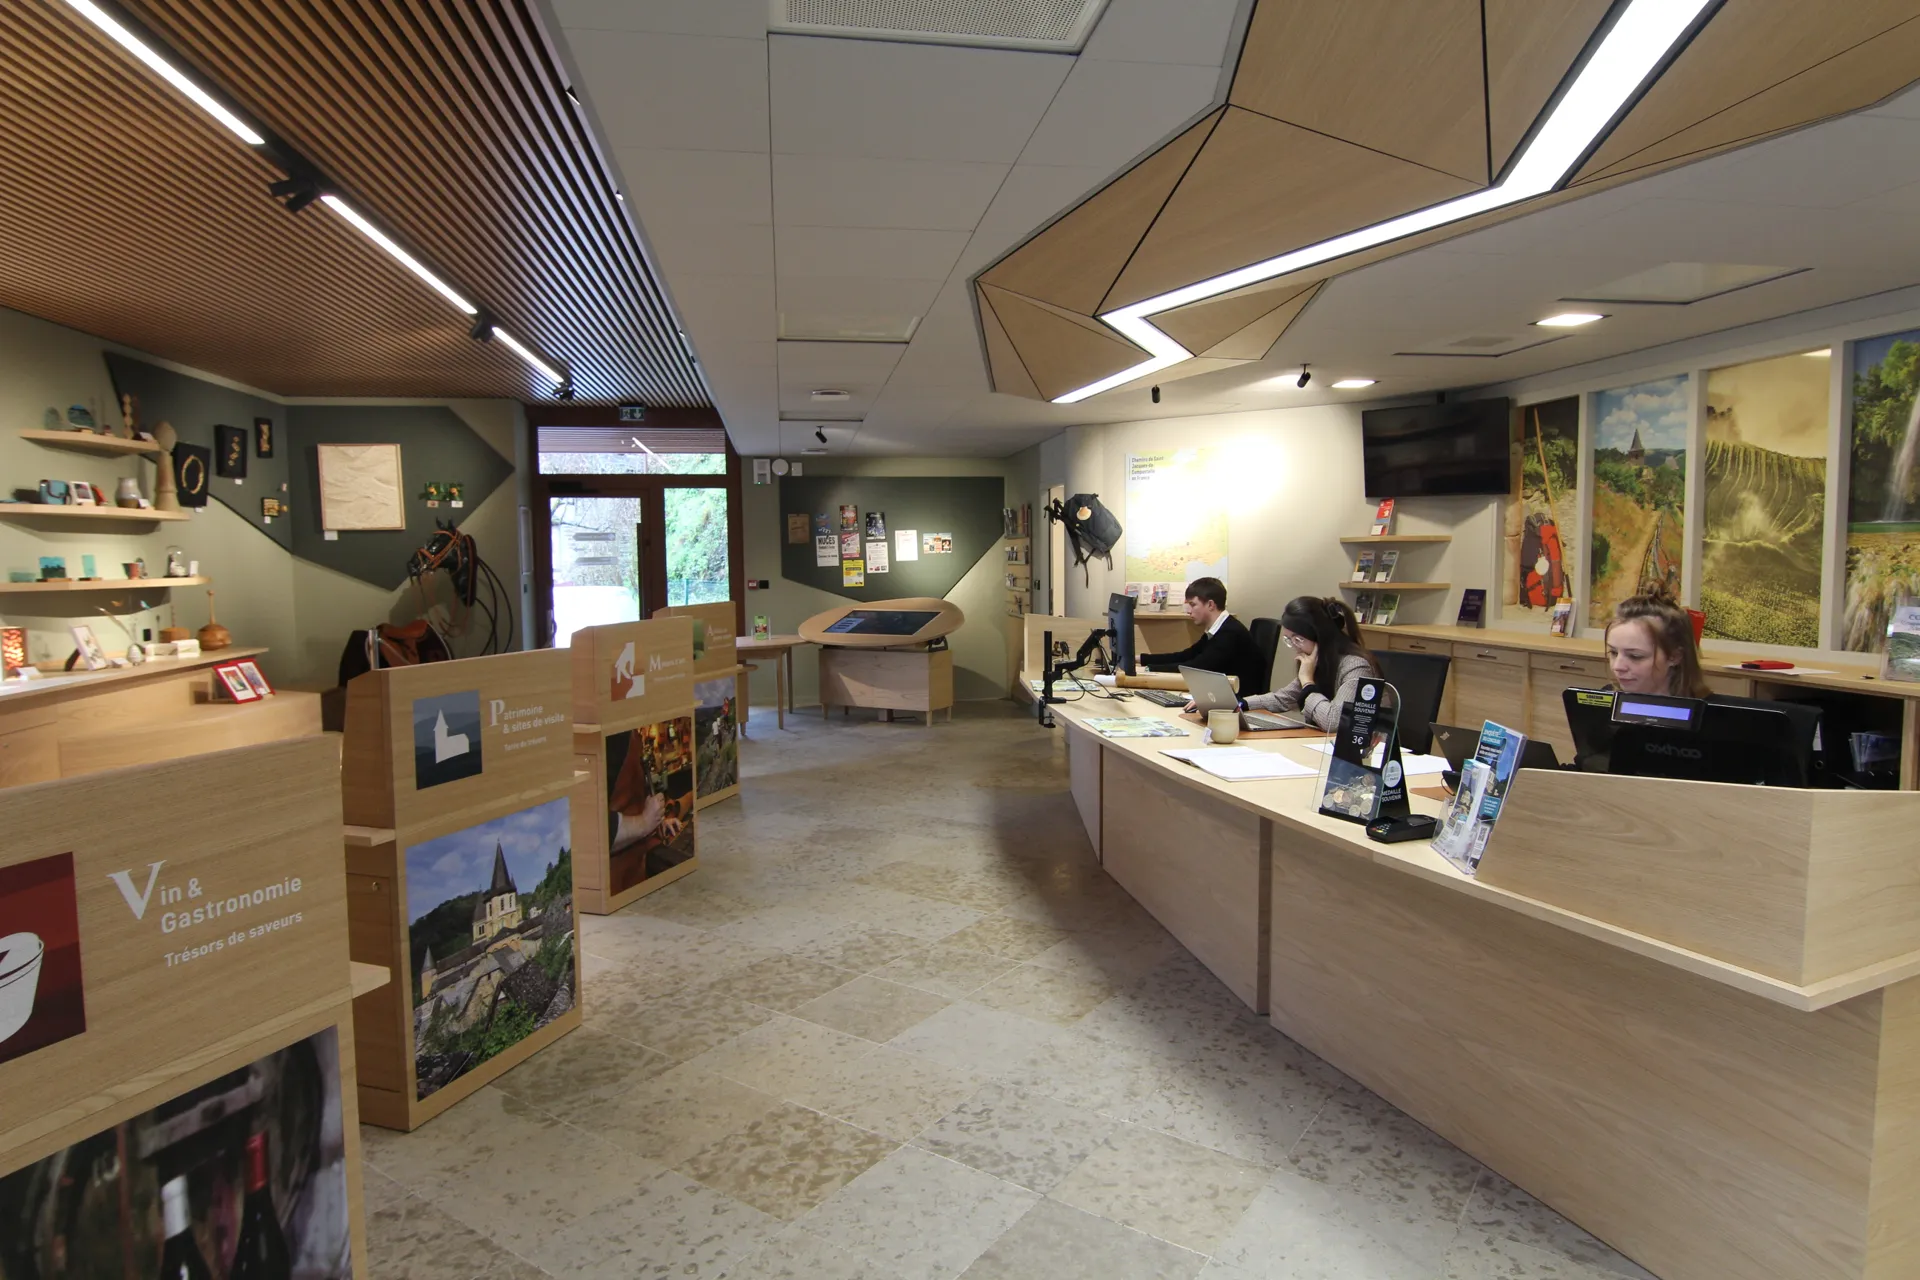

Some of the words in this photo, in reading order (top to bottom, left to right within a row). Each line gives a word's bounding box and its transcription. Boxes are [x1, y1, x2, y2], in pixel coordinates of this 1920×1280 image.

[489, 699, 544, 726] Patrimoine
[503, 723, 510, 734] &
[512, 720, 532, 733] sites
[532, 717, 542, 728] de
[544, 712, 565, 725] visite
[1353, 706, 1376, 714] SOUVENIR
[1352, 735, 1364, 745] 3€
[106, 860, 182, 920] Vin
[188, 878, 203, 898] &
[161, 877, 302, 934] Gastronomie
[164, 939, 224, 968] Trésors
[228, 932, 246, 946] de
[249, 912, 303, 939] saveurs
